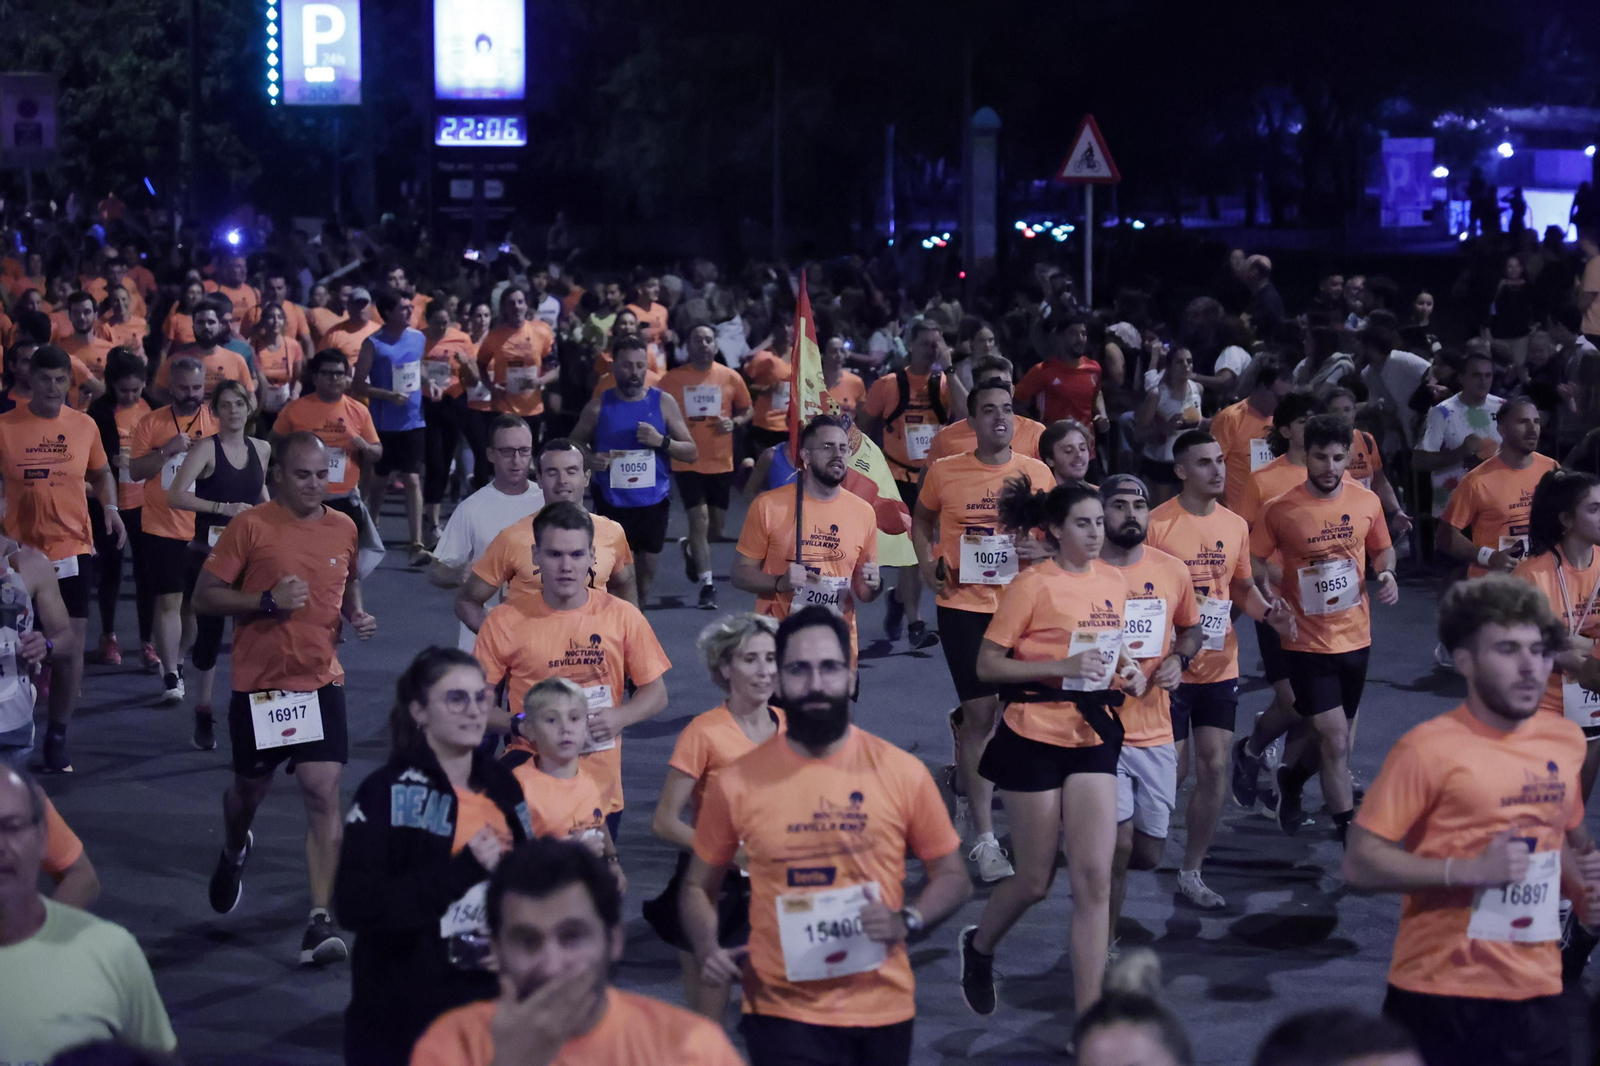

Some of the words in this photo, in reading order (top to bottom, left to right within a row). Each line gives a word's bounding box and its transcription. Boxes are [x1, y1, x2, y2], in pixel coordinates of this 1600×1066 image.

[302, 3, 346, 66] P
[441, 117, 518, 140] 22:06
[916, 436, 933, 444] 102
[620, 462, 647, 472] 10050
[1321, 526, 1353, 535] NOCTURNA
[801, 539, 822, 548] EVILLA
[810, 534, 841, 543] NOCTURNA
[1307, 534, 1336, 544] SEVILLA
[974, 551, 1008, 564] 10075
[1314, 577, 1347, 593] 19553
[807, 590, 840, 605] 20944
[565, 649, 604, 657] NOCTURNA
[548, 659, 582, 668] SEVILLA
[583, 657, 604, 665] KH7
[1583, 690, 1600, 703] 74
[268, 705, 307, 723] 16917
[390, 783, 453, 837] REAL
[1501, 883, 1549, 905] 16897
